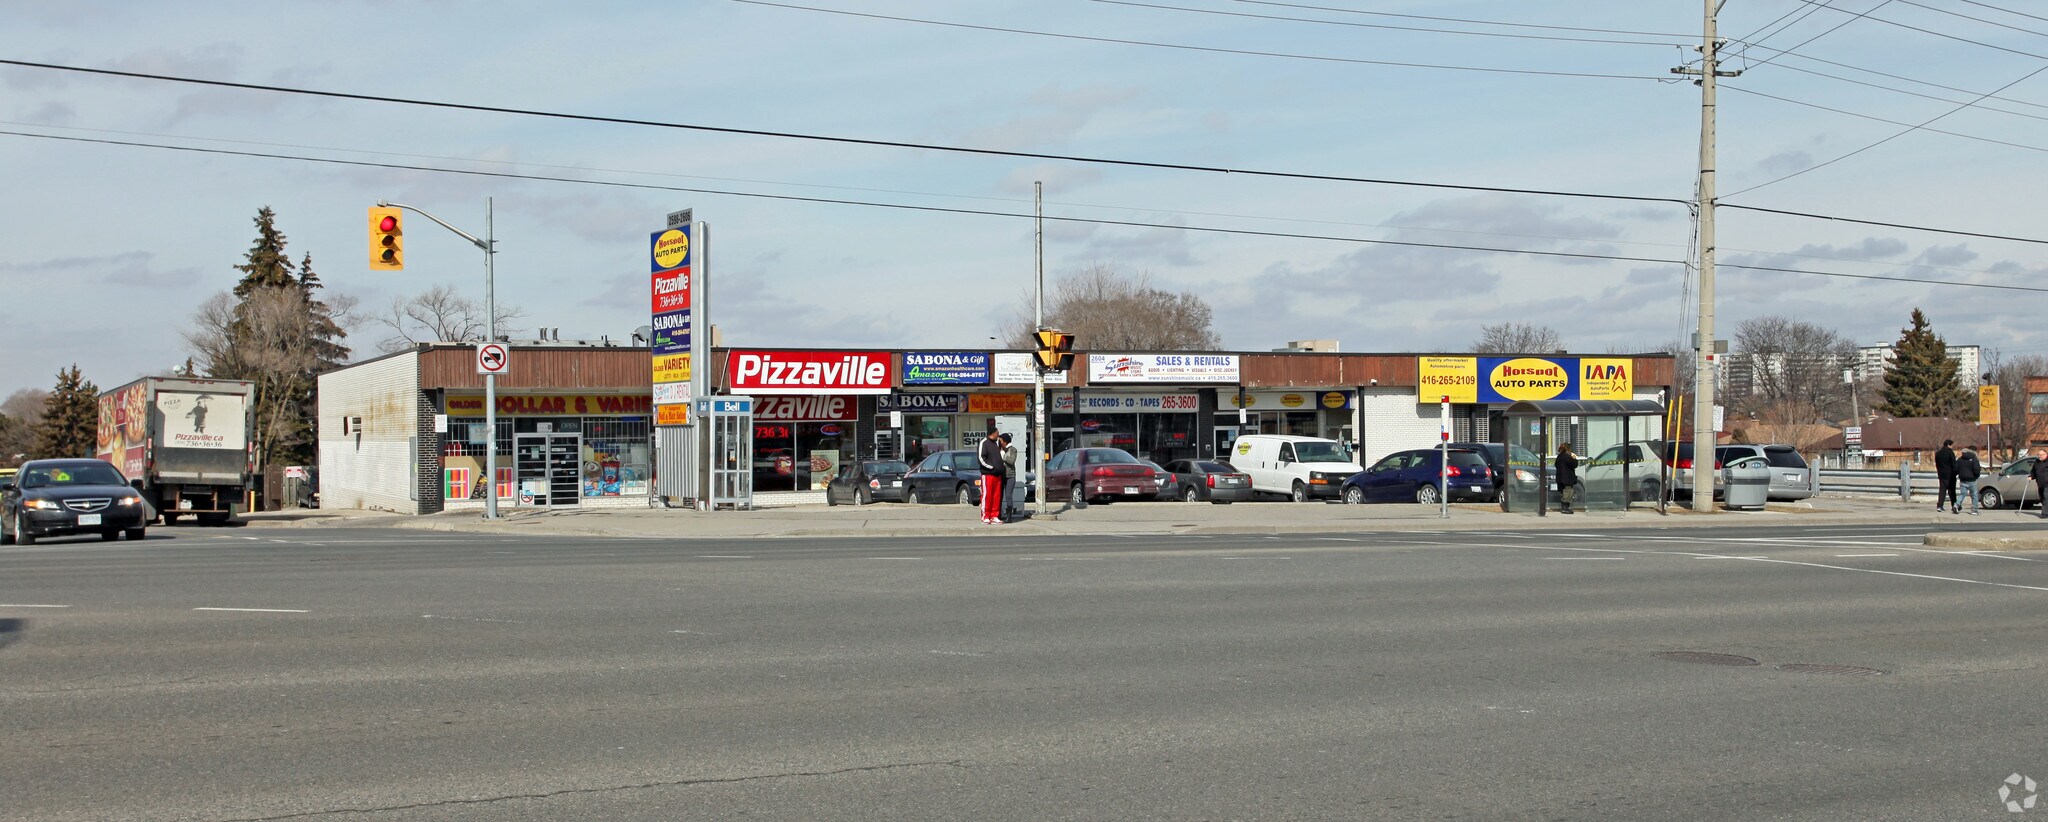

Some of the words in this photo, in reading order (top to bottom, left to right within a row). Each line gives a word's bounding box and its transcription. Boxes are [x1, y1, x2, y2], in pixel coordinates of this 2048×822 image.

[655, 249, 670, 258] AUTO
[670, 245, 688, 255] PARTS
[655, 273, 688, 295] Pizzaville
[654, 314, 683, 330] SABONA
[664, 357, 691, 371] VARIETY
[906, 355, 962, 365] SABONA
[970, 355, 984, 364] Gift
[1105, 357, 1144, 374] Sunshine
[1156, 356, 1182, 366] SALES
[1184, 356, 1191, 366] &
[1194, 356, 1231, 366] RENTALS
[736, 354, 886, 386] Pizzaville
[909, 366, 946, 379] Amazon
[1502, 365, 1559, 378] Hotspot
[1585, 364, 1627, 380] IAPA
[575, 396, 588, 413] &
[724, 401, 740, 412] Bell
[990, 398, 1004, 408] Hair
[1005, 398, 1023, 408] Salon
[1088, 398, 1120, 407] RECORDS
[1125, 398, 1135, 407] CD
[1139, 398, 1160, 407] TAPES
[1162, 395, 1197, 409] 265-3600
[755, 426, 776, 439] 736
[963, 438, 985, 446] SH
